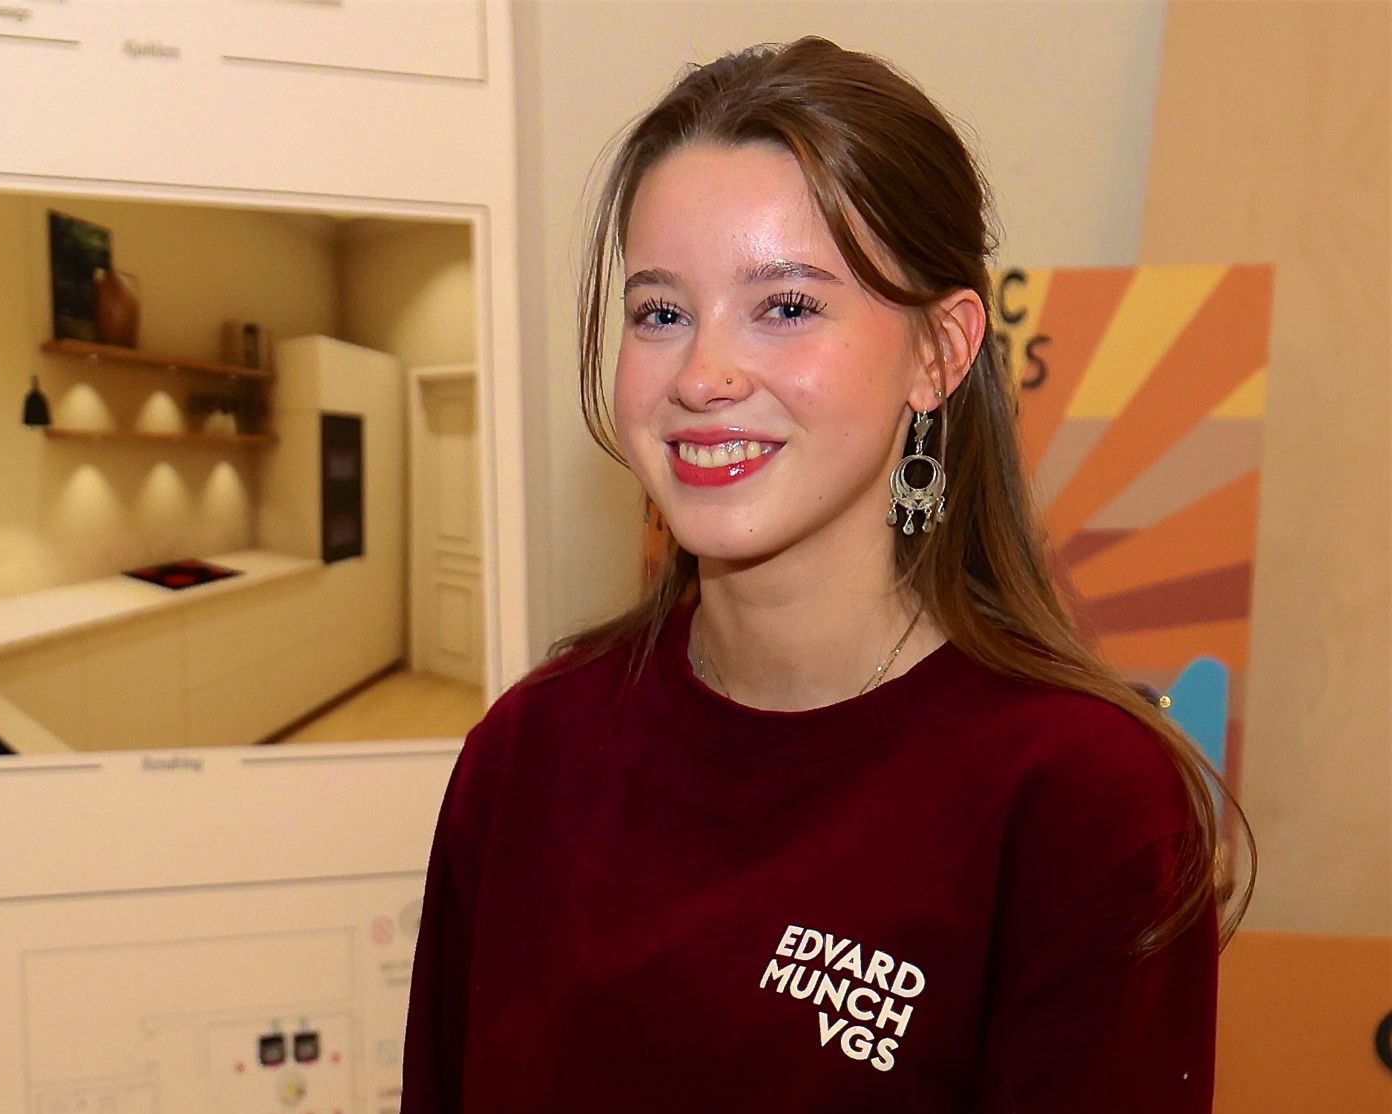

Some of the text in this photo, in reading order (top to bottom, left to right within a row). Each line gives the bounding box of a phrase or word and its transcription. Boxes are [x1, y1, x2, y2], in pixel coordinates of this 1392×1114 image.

[759, 959, 914, 1037] MUNCH
[776, 925, 926, 998] EDVARD
[819, 1012, 899, 1072] VGS
